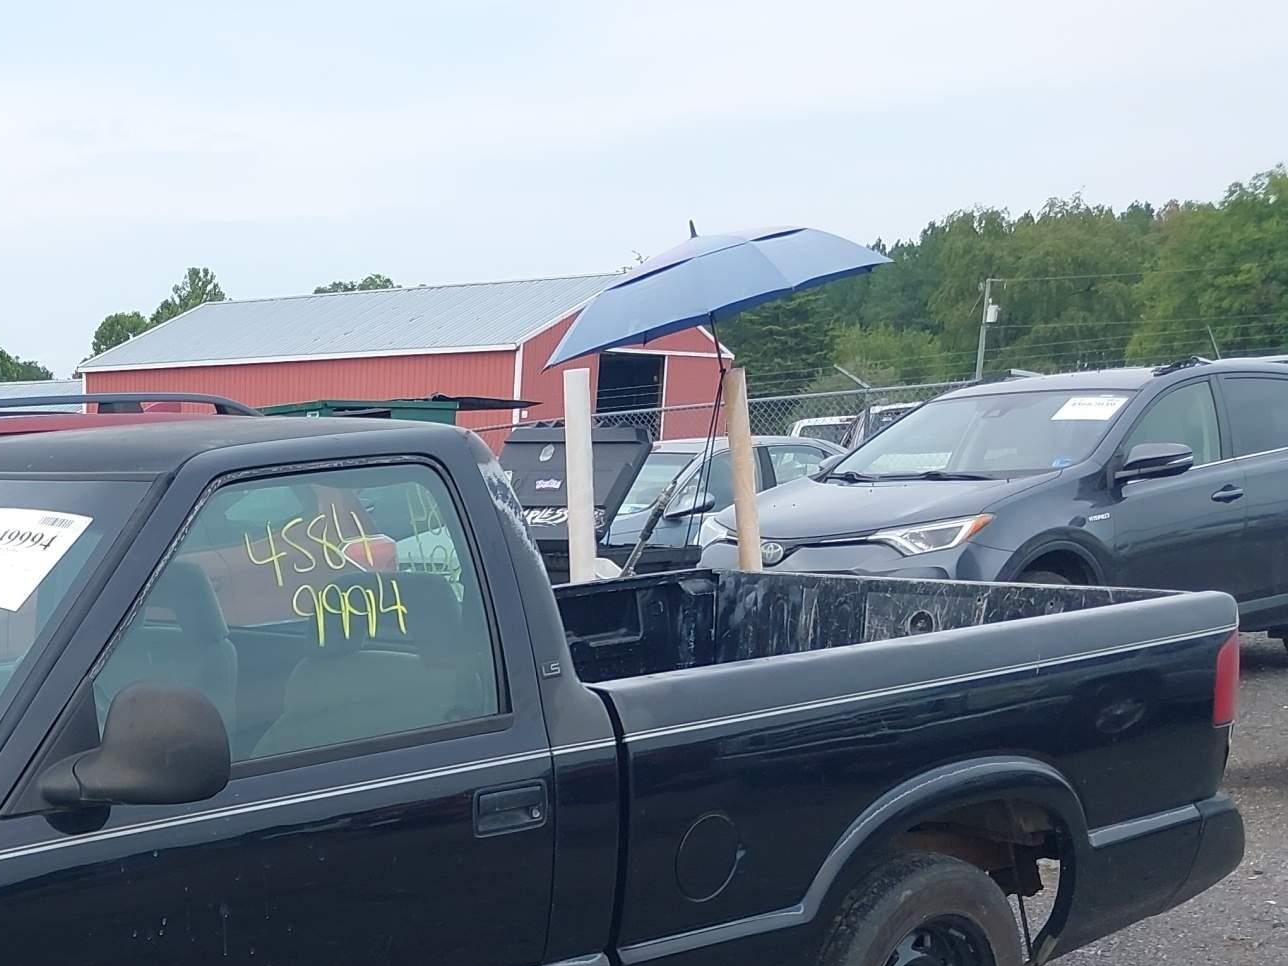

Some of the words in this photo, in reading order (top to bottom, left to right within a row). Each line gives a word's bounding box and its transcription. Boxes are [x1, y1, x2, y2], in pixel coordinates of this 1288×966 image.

[244, 503, 376, 587] 4584
[292, 572, 408, 647] 9994
[542, 662, 561, 676] LS
